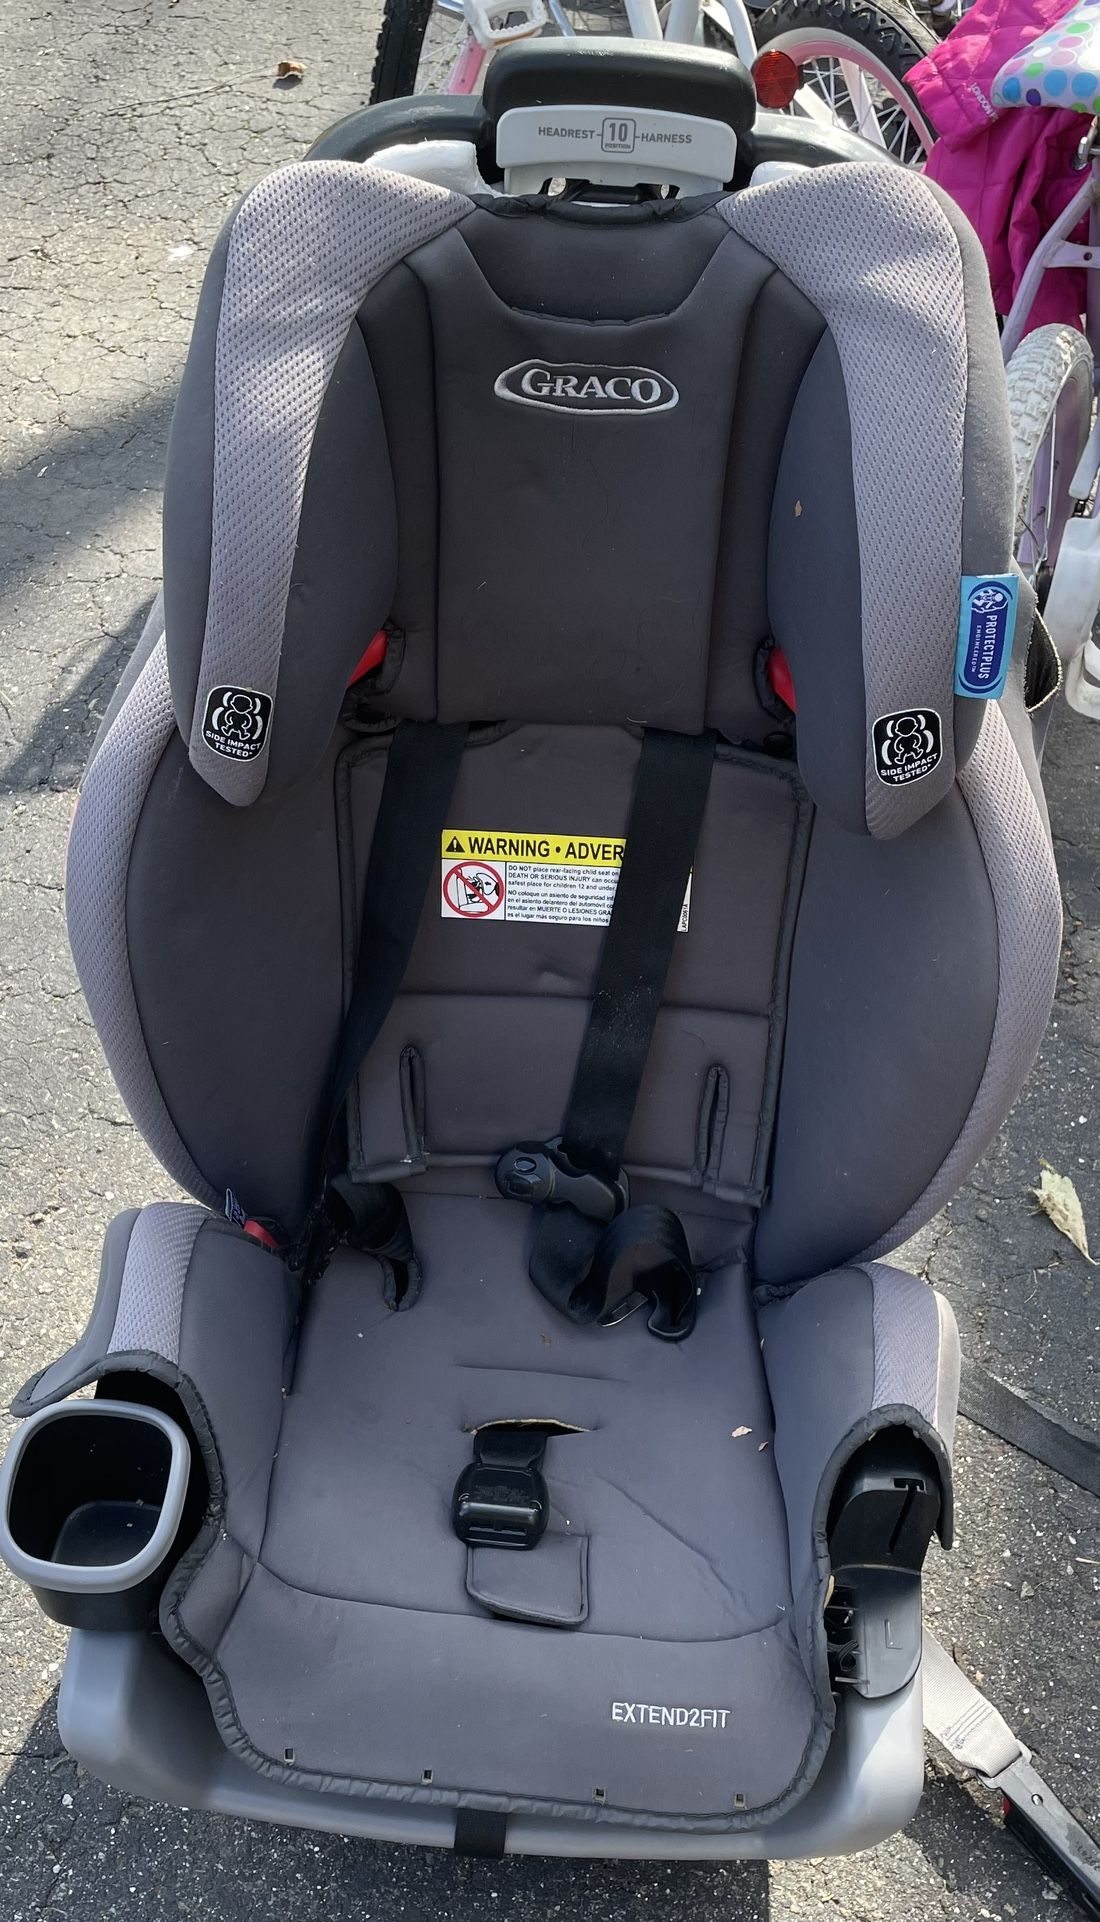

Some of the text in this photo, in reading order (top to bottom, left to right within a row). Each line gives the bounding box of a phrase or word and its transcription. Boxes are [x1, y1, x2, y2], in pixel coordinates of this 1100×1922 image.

[970, 82, 992, 114] LONDON
[538, 126, 596, 140] HEADREST
[609, 122, 628, 142] 10
[641, 132, 692, 144] HARNESS
[521, 368, 662, 404] GRACO
[978, 614, 998, 679] PROTECTPLUS
[205, 730, 261, 750] SIDE IMPACT
[880, 753, 938, 776] SIDE IMPACT
[468, 837, 550, 857] WARNING
[612, 1702, 730, 1728] EXTEND2FIT
